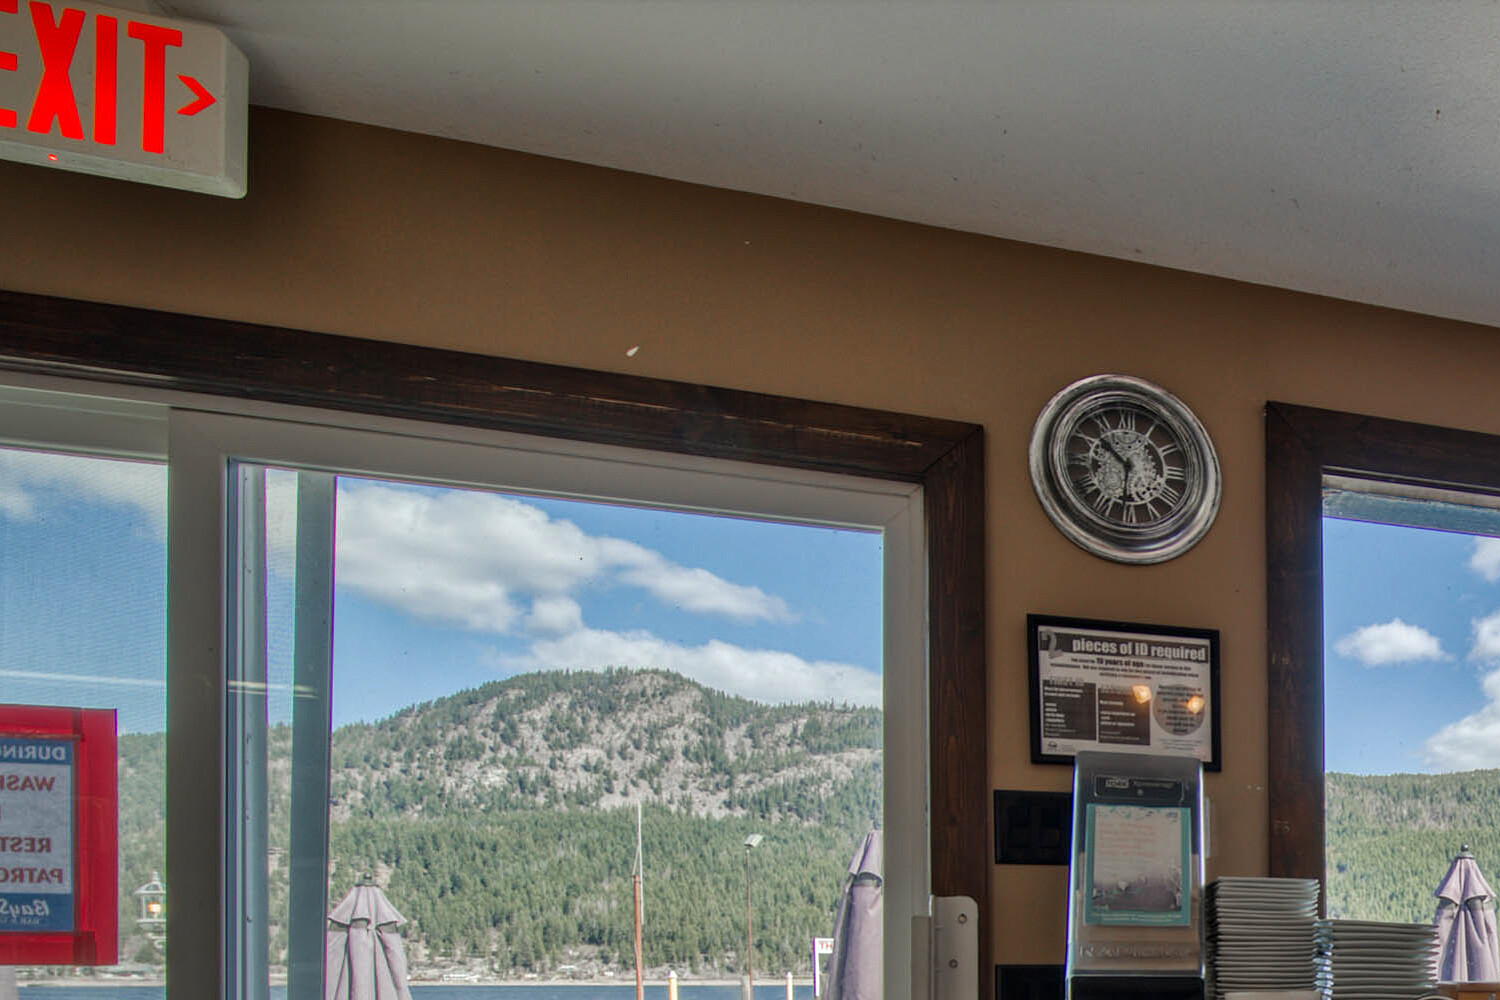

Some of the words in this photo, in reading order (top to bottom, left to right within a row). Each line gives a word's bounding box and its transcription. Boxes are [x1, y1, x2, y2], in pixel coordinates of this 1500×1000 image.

[1072, 638, 1116, 653] pieces
[1119, 642, 1133, 655] of
[1135, 643, 1149, 656] ID
[1151, 645, 1206, 661] required
[1105, 659, 1123, 667] years
